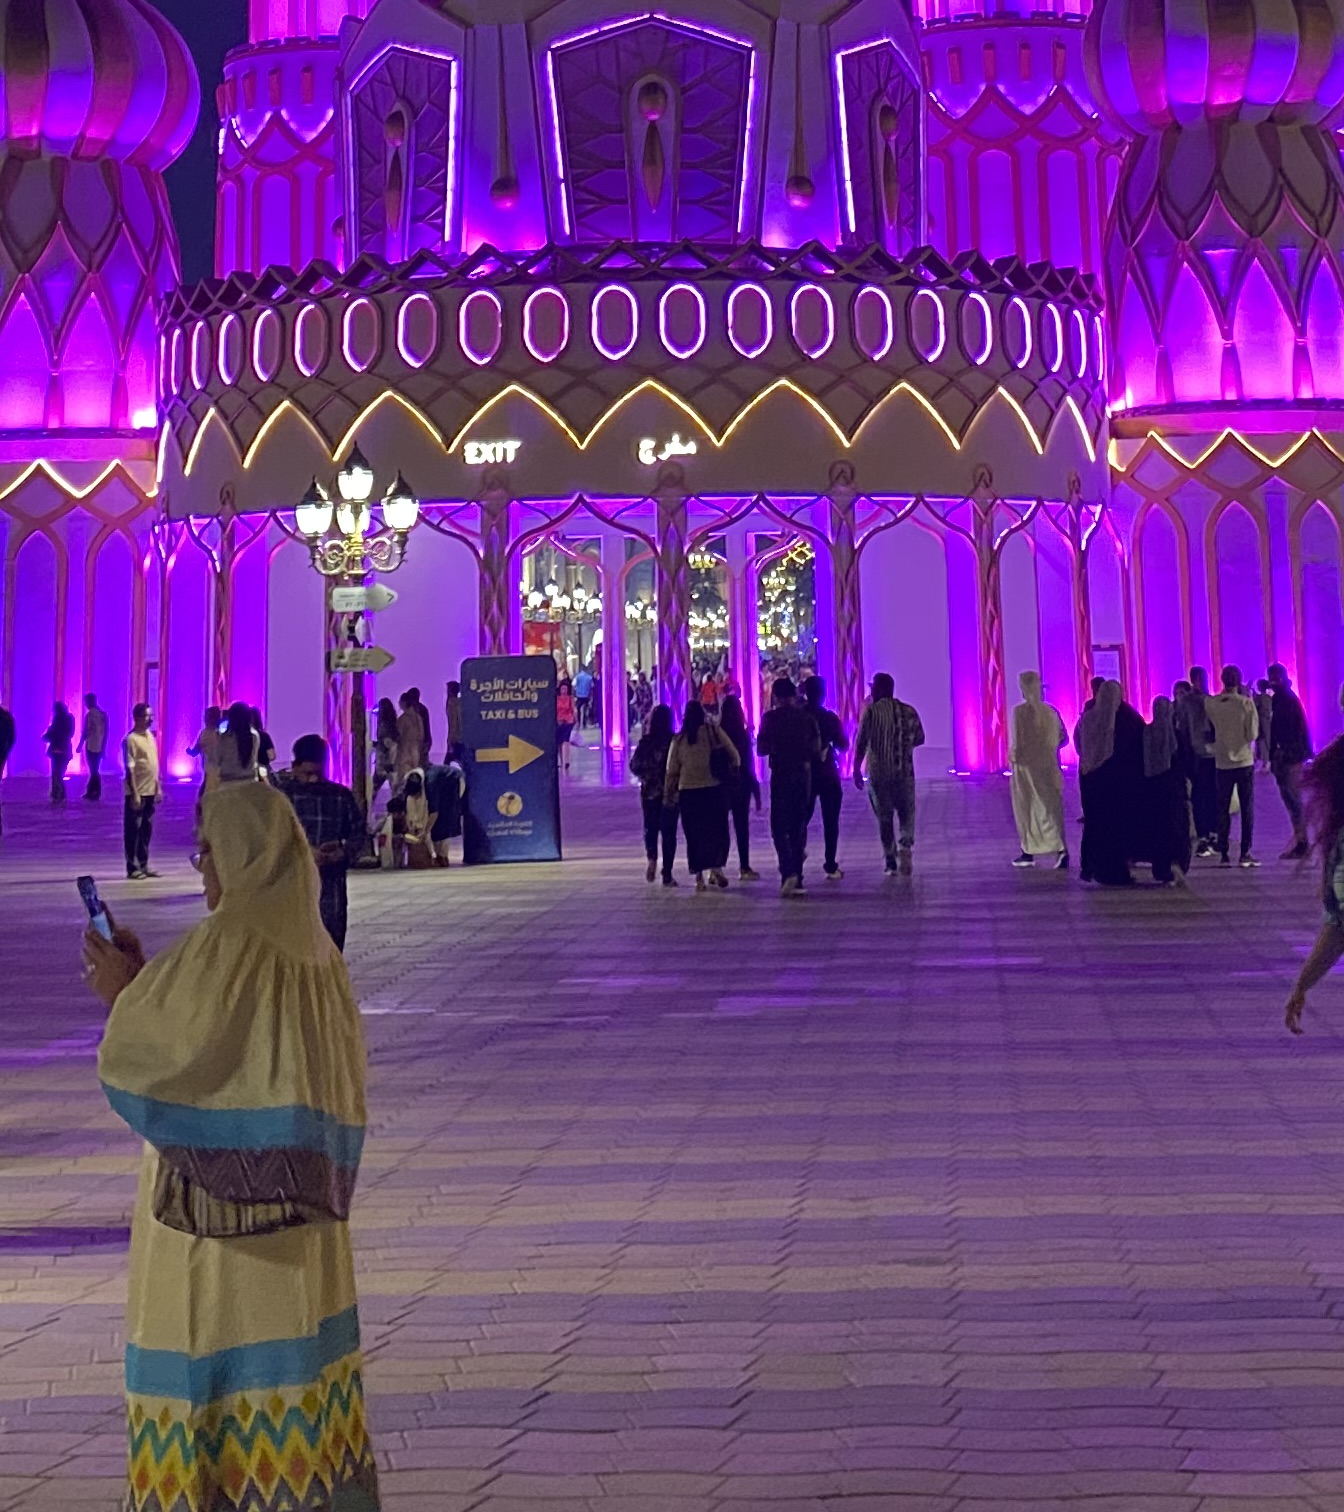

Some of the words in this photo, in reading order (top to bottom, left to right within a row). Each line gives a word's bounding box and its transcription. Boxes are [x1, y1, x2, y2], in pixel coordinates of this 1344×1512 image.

[463, 440, 522, 464] EXIT
[506, 678, 549, 692] سيارات
[480, 690, 539, 703] والحافلات
[480, 709, 506, 720] TAXI
[507, 710, 516, 719] &
[517, 709, 539, 719] BUS
